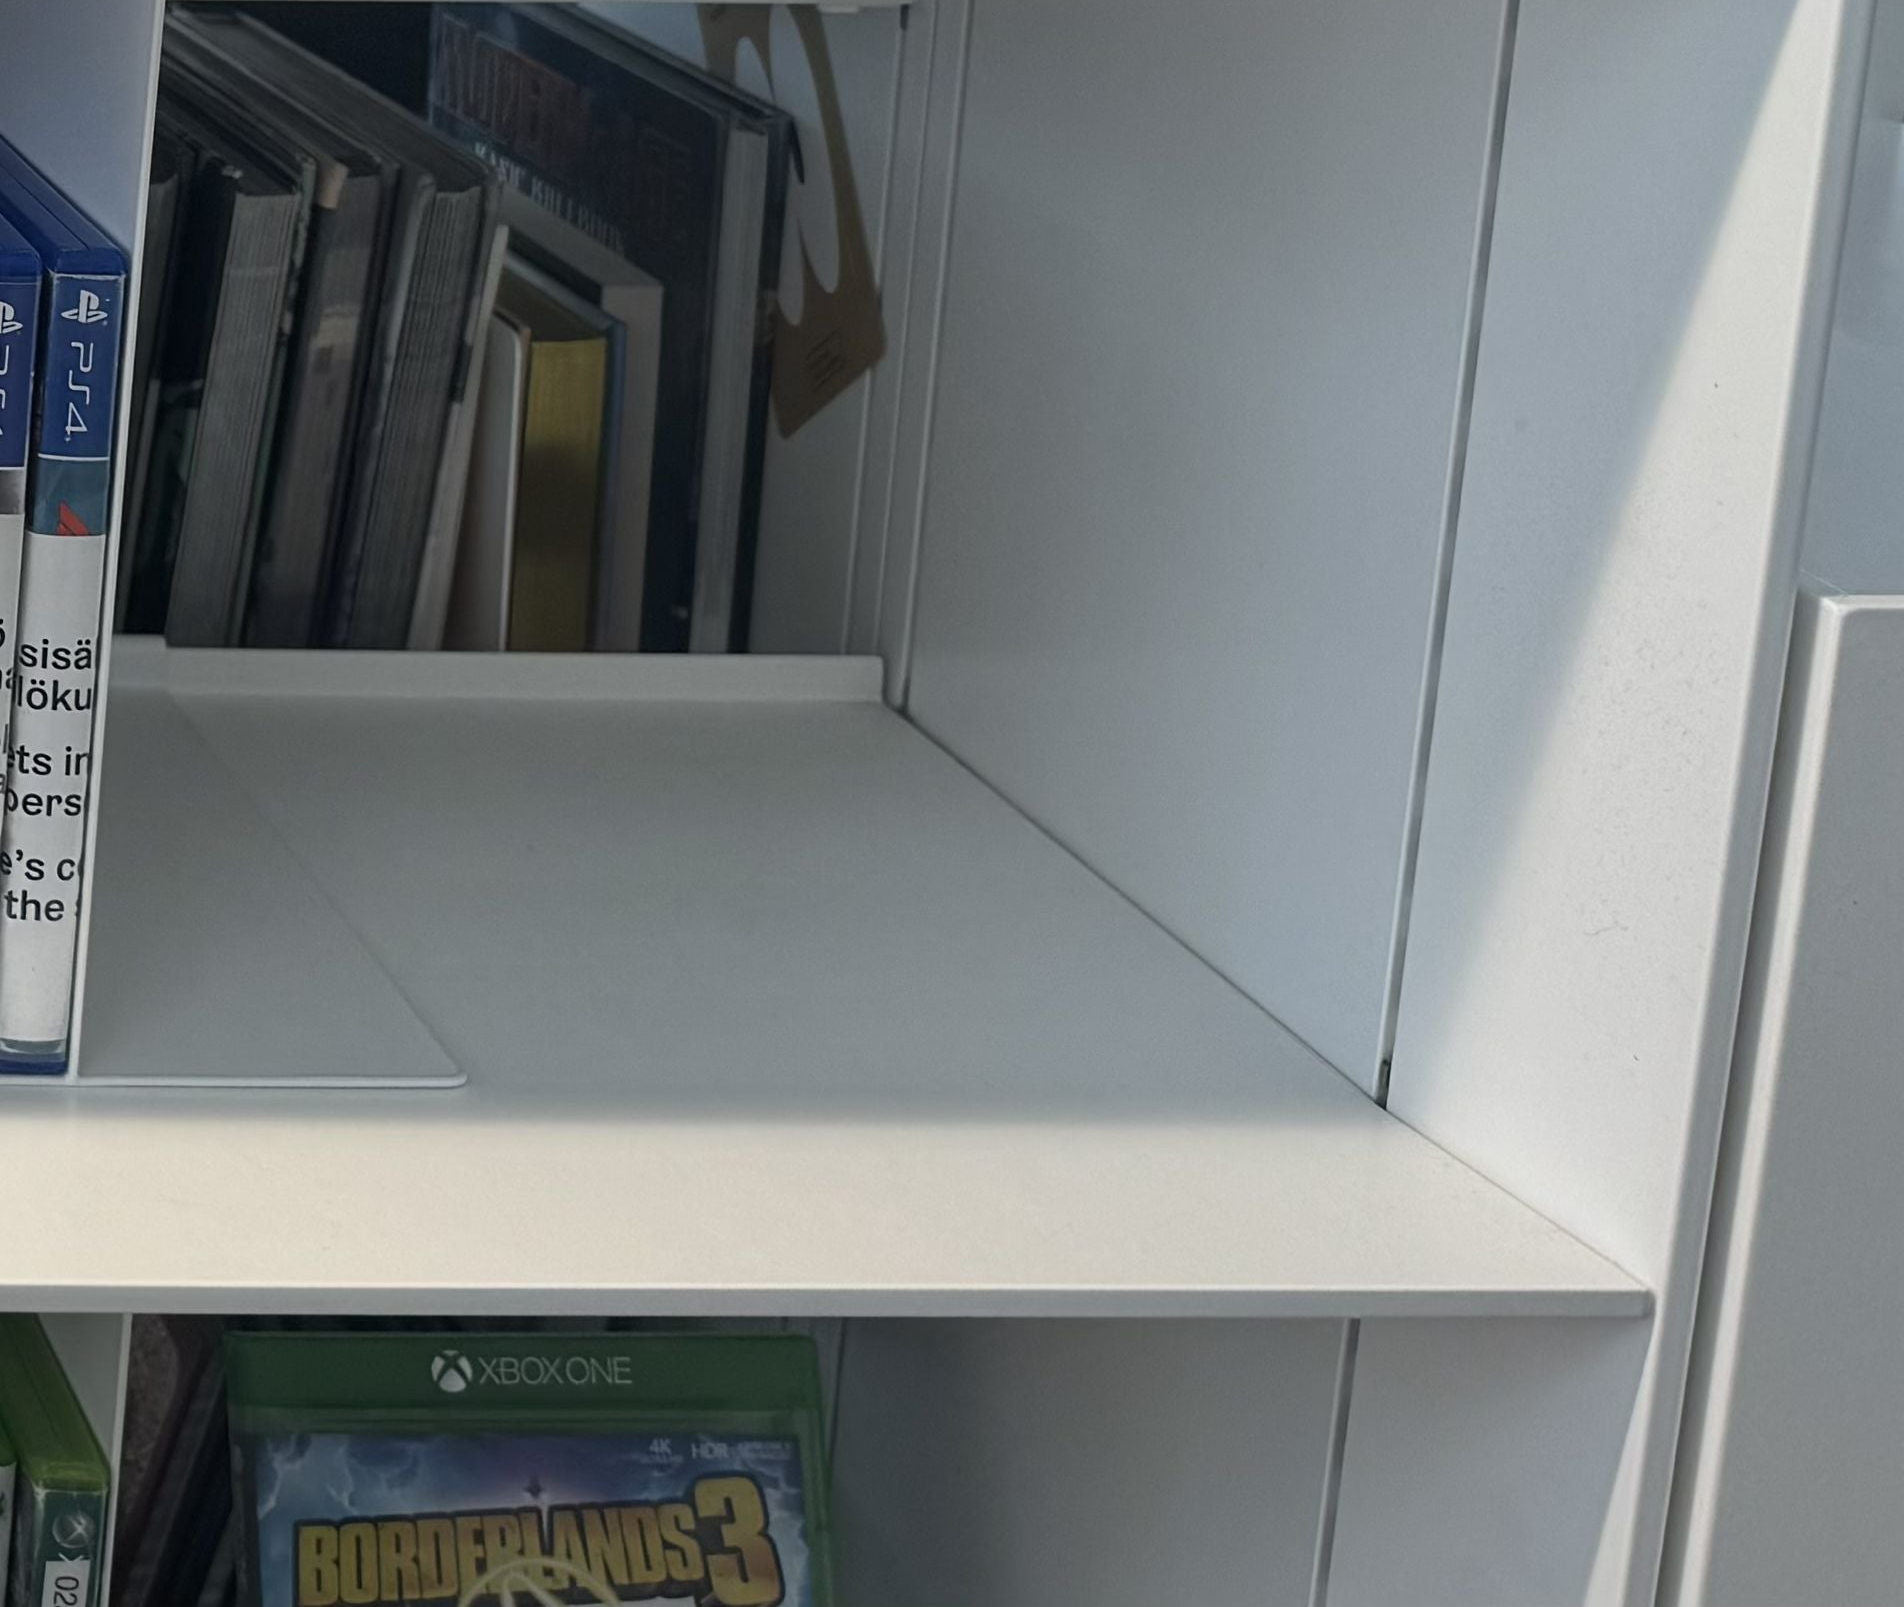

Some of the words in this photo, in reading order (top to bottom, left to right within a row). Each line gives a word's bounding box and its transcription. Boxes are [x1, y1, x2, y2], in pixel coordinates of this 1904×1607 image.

[478, 1357, 565, 1384] XBOX
[566, 1357, 632, 1384] ONE
[299, 1504, 702, 1607] BORDERLANDS
[695, 1477, 783, 1605] 3
